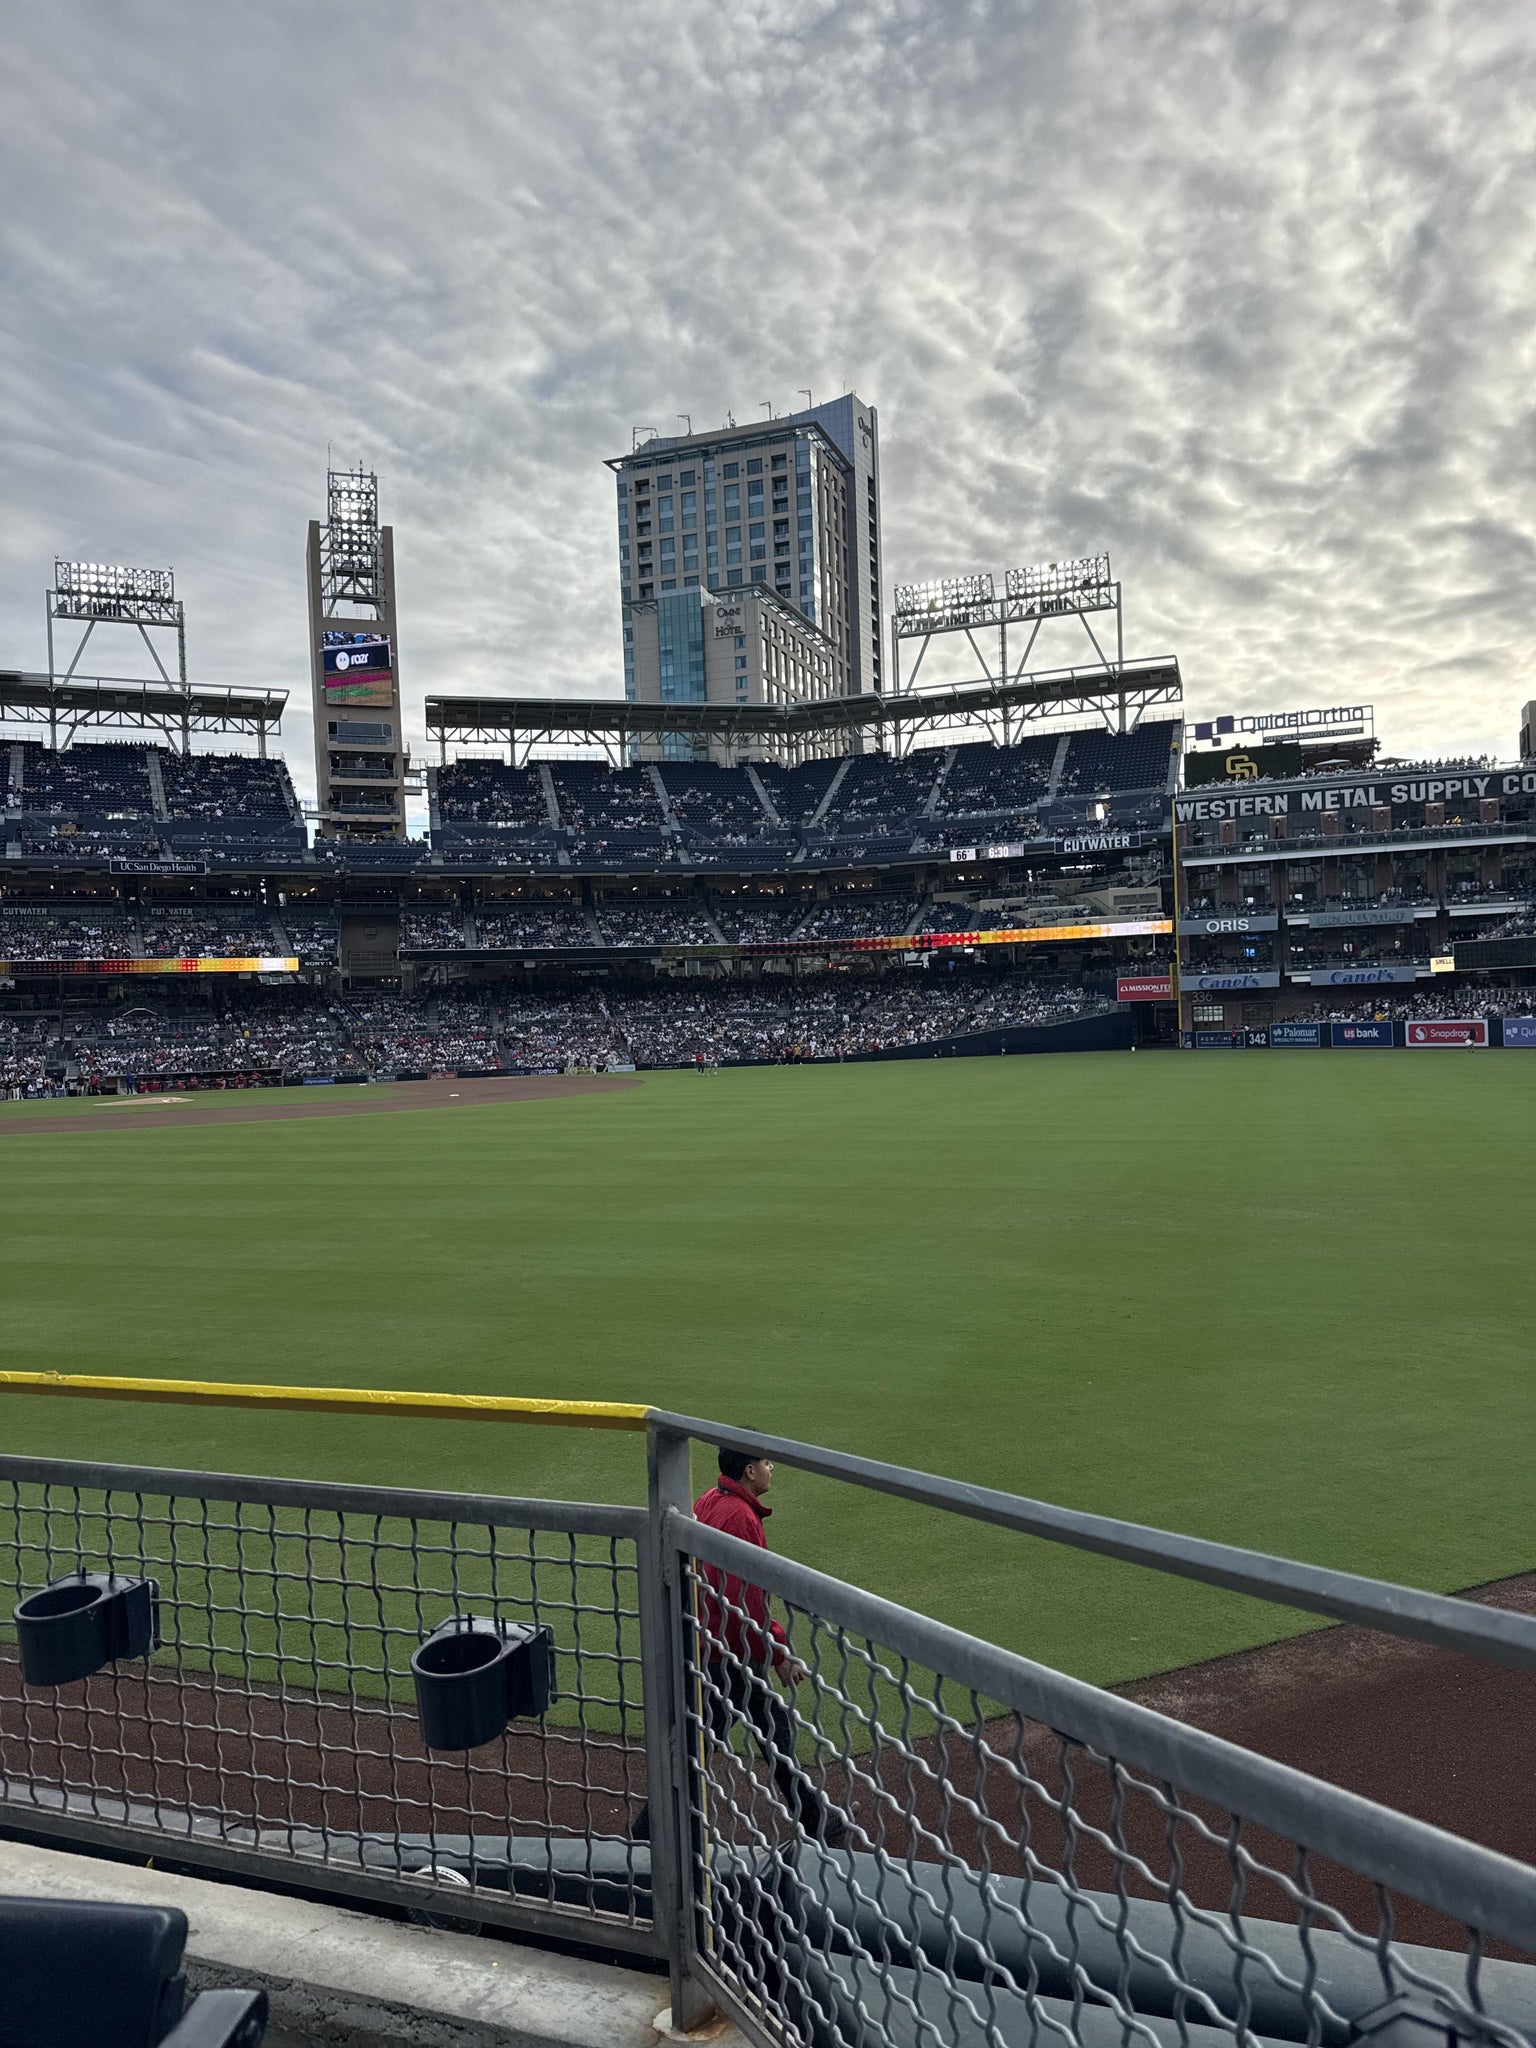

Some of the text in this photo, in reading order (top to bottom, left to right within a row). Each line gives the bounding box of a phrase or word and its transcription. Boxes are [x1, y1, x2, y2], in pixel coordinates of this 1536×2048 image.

[715, 626, 744, 637] HOTEL
[350, 653, 369, 665] razr
[1241, 706, 1363, 733] QuidelOrtho
[1266, 728, 1362, 743] OFFICIAL DIAGNOSTICS PARTNER
[1176, 794, 1288, 822] WESTERN
[1301, 786, 1384, 812] METAL
[1391, 777, 1490, 804] SUPPLY
[1063, 836, 1130, 852] CUTWATER
[989, 846, 1009, 859] 6:30
[120, 862, 197, 873] UC San Diego Health
[1206, 919, 1249, 933] ORIS
[1199, 974, 1259, 989] Canel's
[1330, 969, 1394, 983] Canel's
[1129, 984, 1159, 992] MISSION
[1191, 991, 1213, 1003] 336
[1283, 1027, 1317, 1037] Palomar
[1344, 1027, 1379, 1038] us bank
[1249, 1033, 1267, 1045] 342
[538, 1067, 558, 1075] petco
